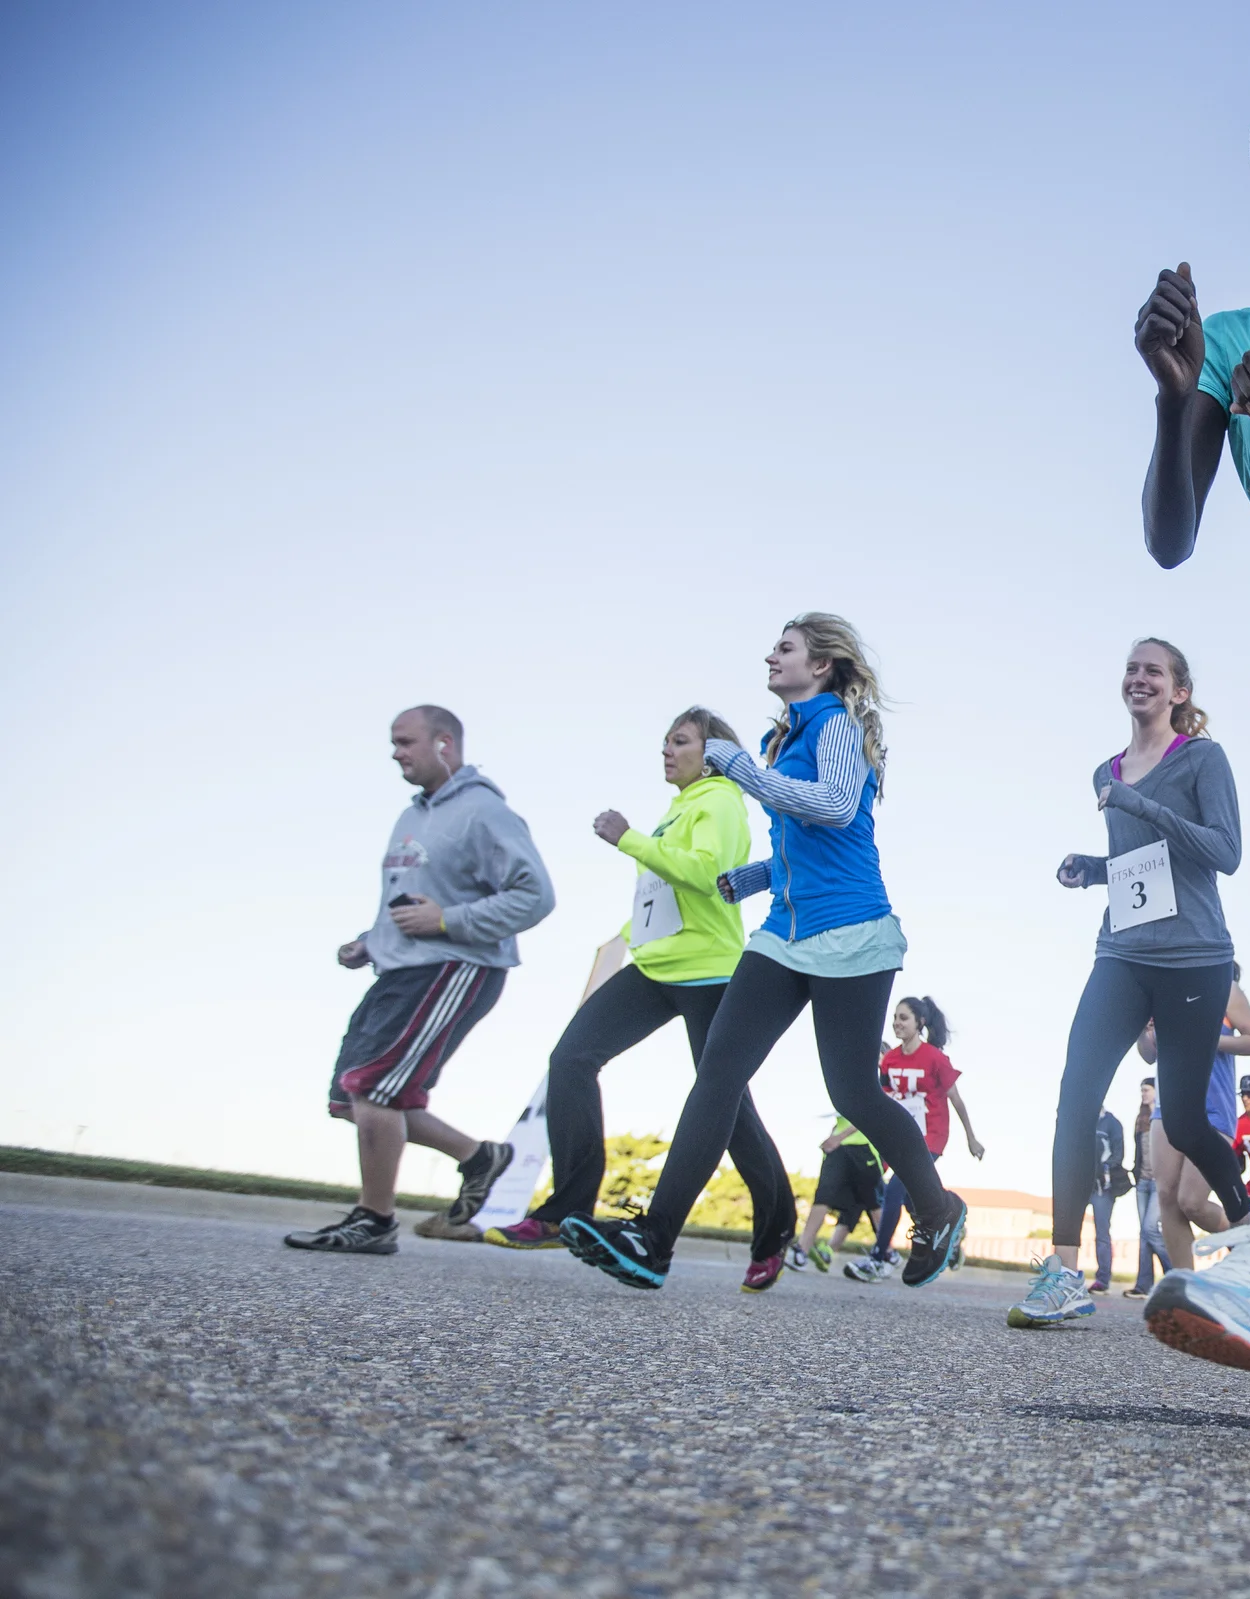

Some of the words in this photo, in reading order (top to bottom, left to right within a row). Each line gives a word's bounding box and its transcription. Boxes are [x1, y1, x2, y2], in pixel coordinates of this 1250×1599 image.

[1111, 866, 1135, 884] FT5K
[1138, 857, 1165, 874] 2014
[1131, 880, 1148, 910] 3
[643, 899, 654, 928] 7
